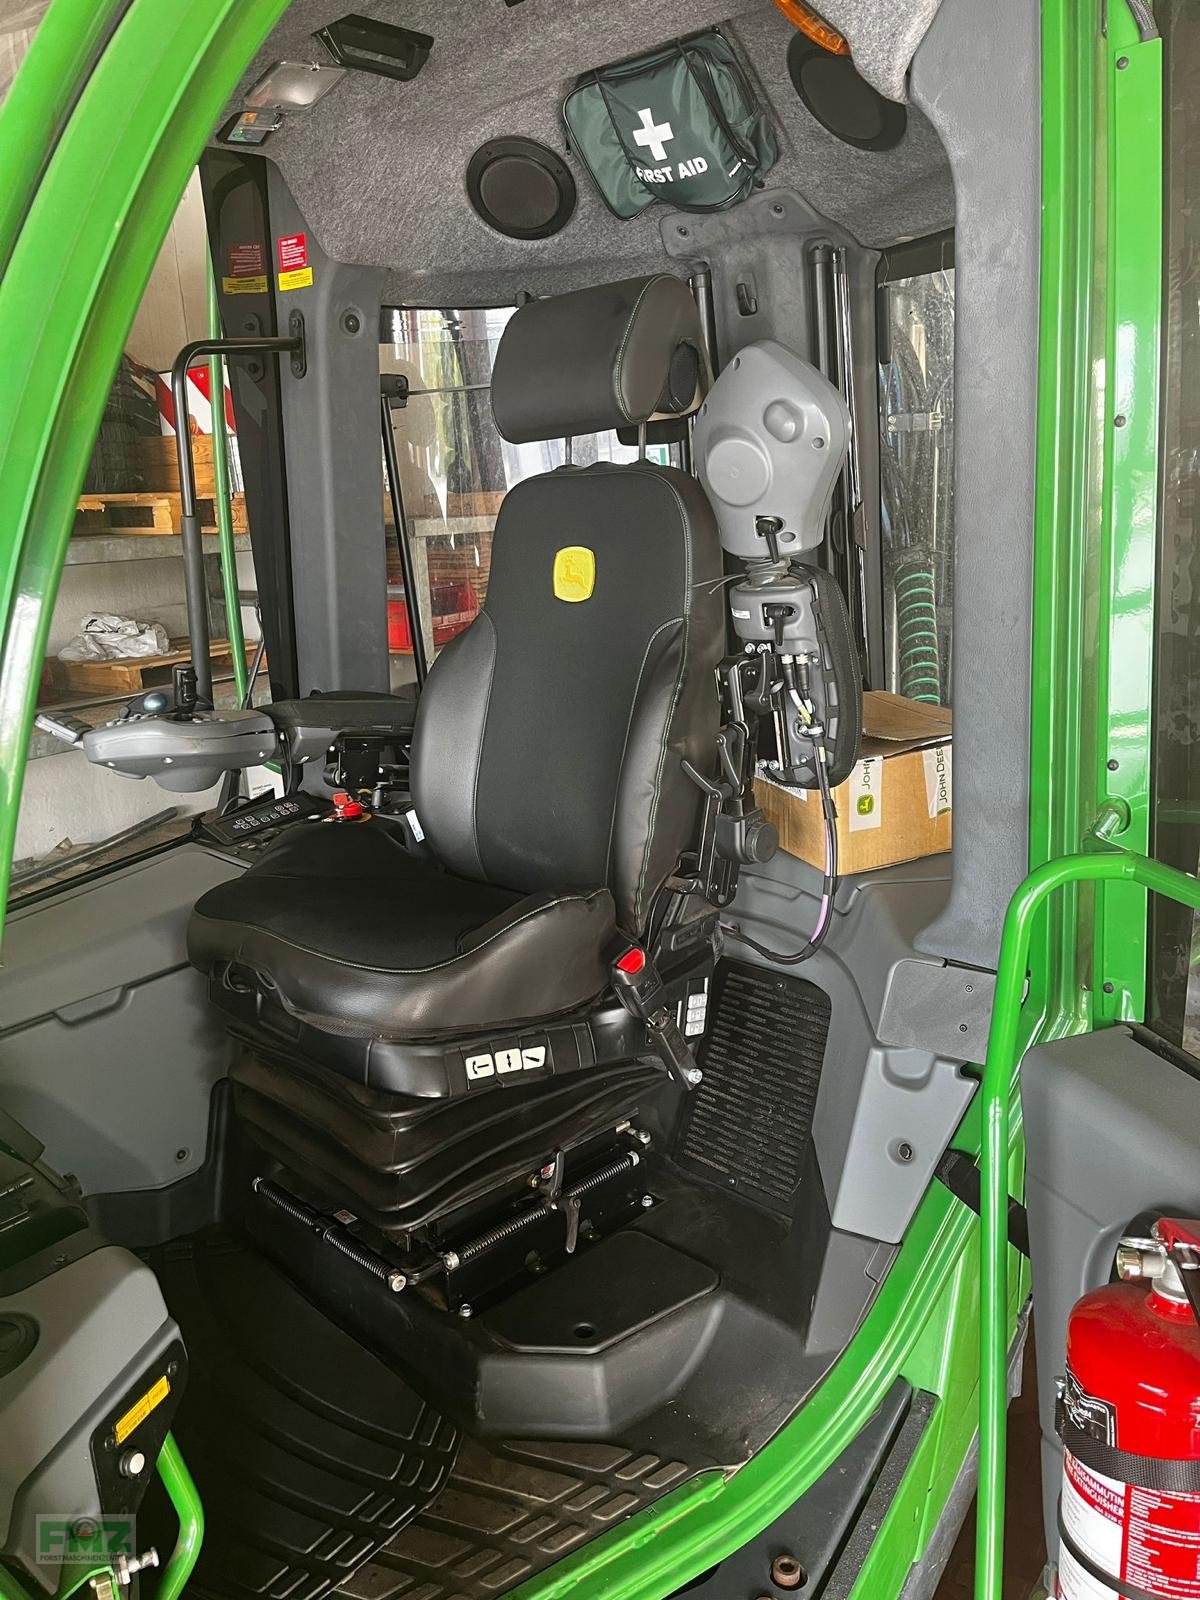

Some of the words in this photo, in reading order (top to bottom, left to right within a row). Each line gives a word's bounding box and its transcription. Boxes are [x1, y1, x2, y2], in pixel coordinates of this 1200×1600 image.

[636, 166, 674, 183] FIRST
[678, 157, 708, 179] AID
[936, 747, 945, 773] DEE
[939, 773, 948, 803] JOHN
